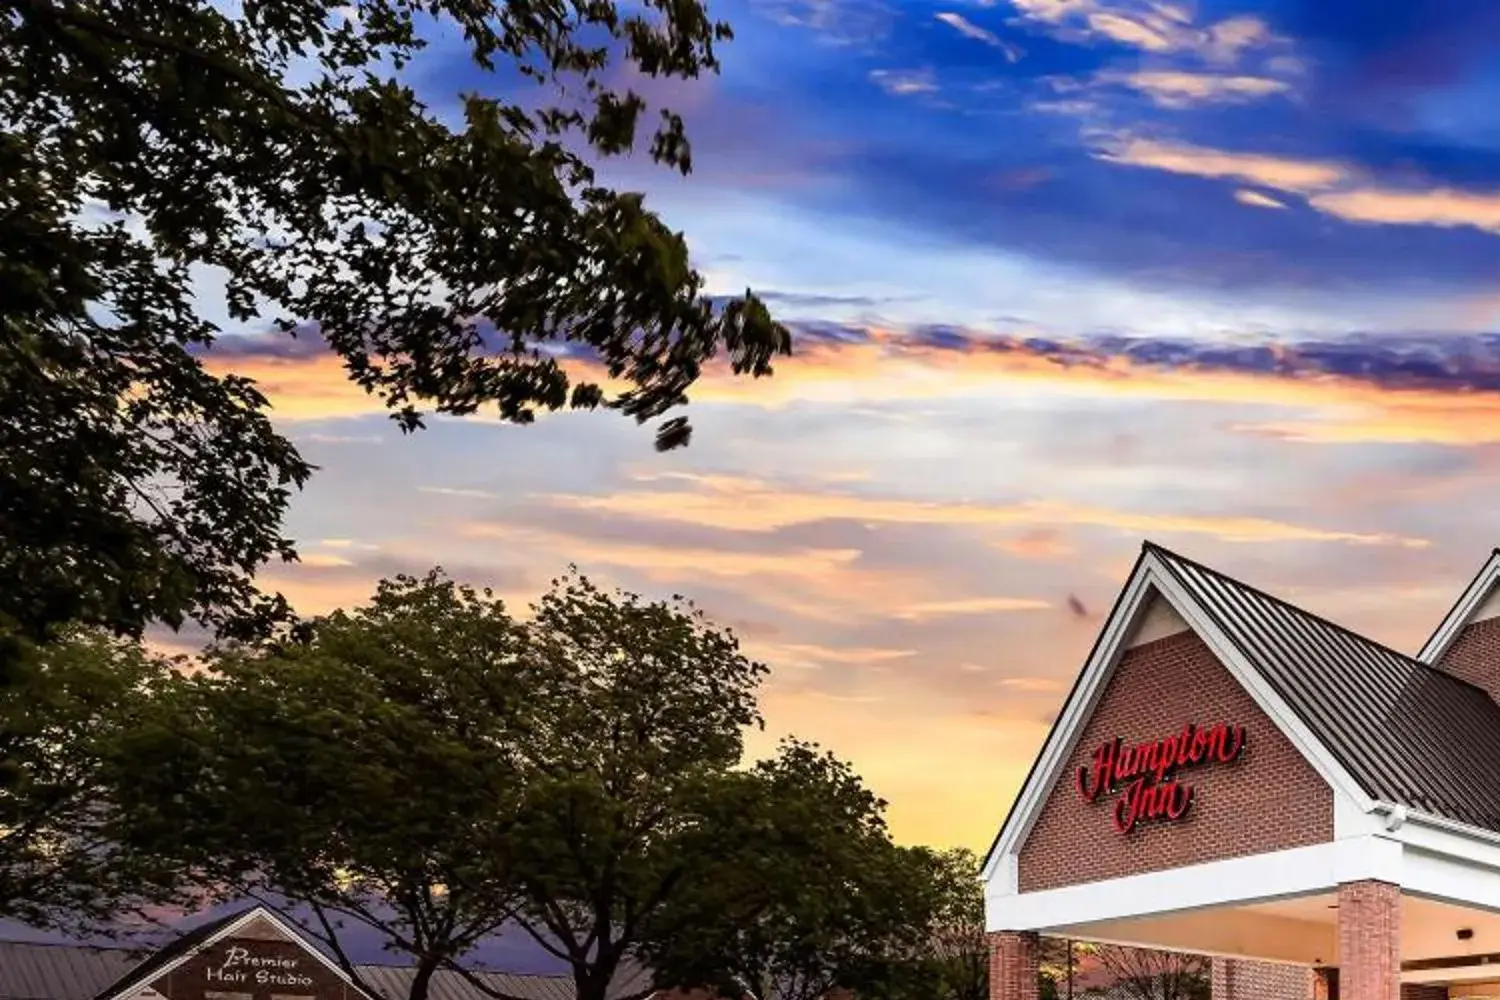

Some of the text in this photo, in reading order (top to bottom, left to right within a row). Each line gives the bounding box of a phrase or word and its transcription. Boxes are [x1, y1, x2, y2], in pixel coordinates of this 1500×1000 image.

[1076, 722, 1243, 801] Hampton
[1112, 776, 1192, 833] Inn
[206, 967, 313, 986] Hair Studio
[223, 946, 298, 968] Premier
